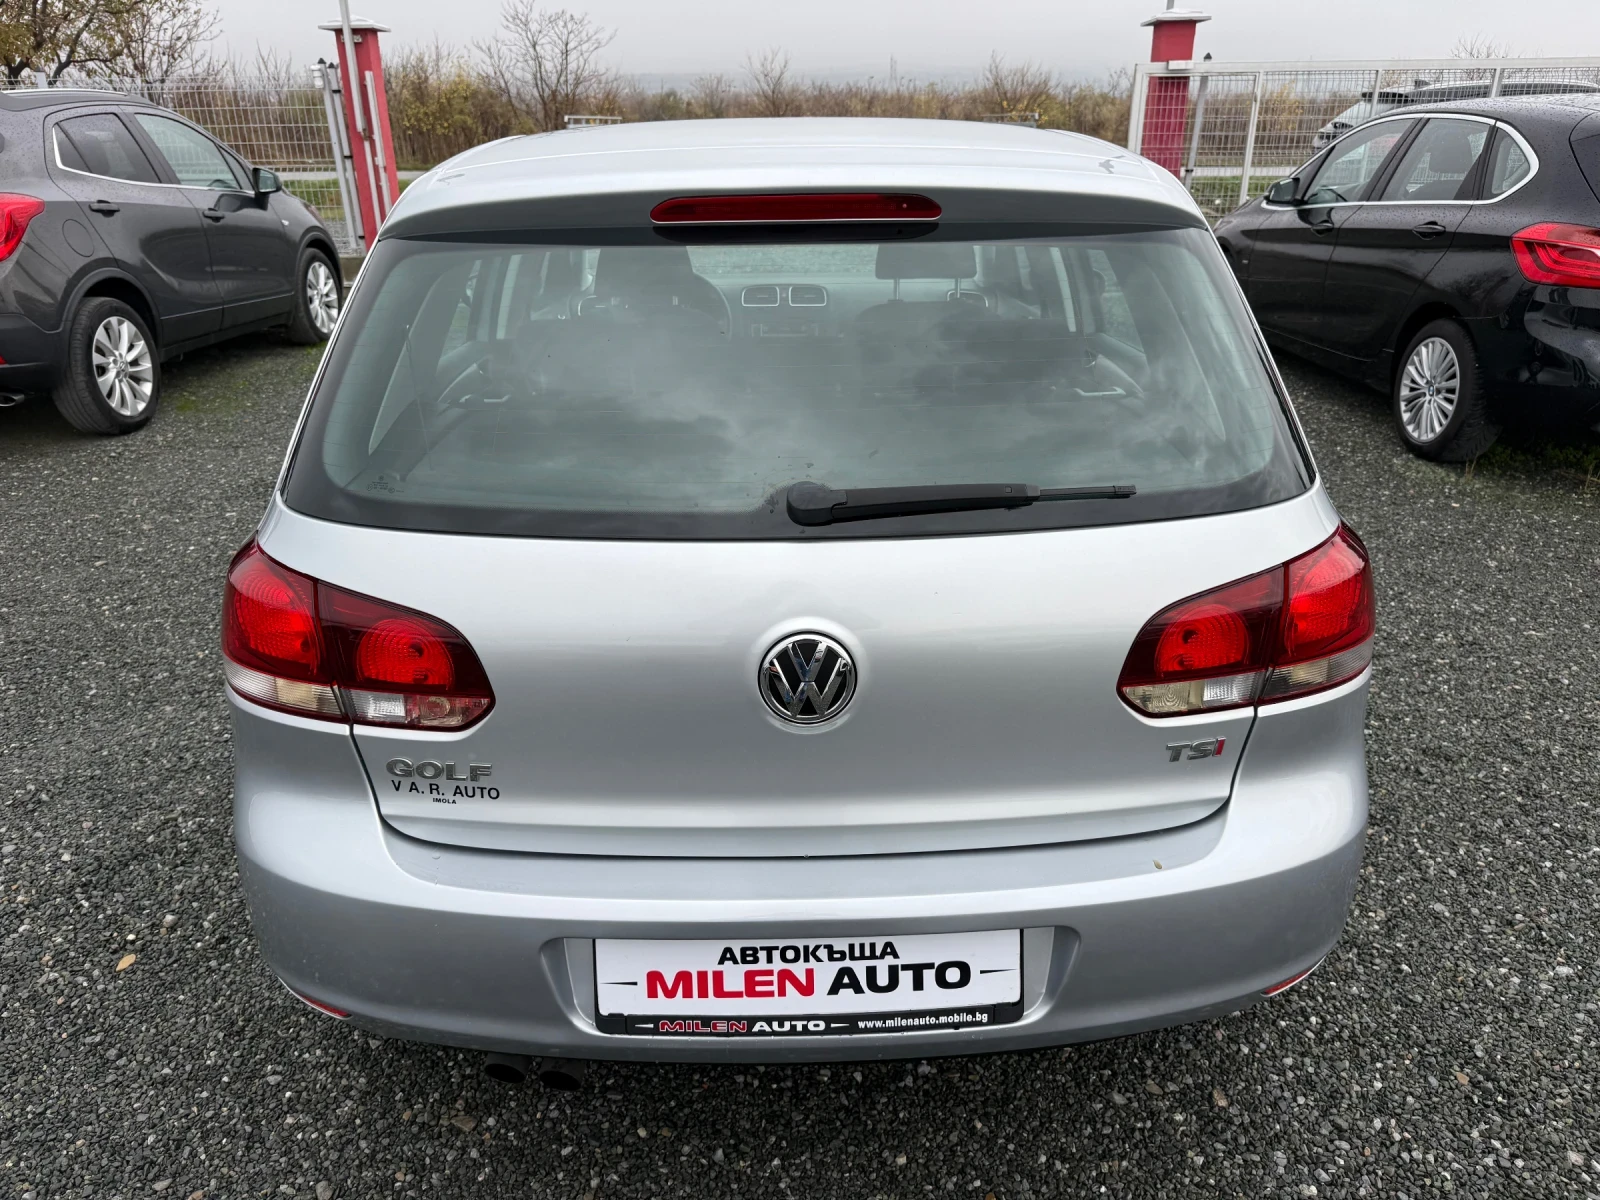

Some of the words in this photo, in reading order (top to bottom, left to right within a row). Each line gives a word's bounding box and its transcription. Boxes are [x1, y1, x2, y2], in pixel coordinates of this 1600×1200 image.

[386, 757, 492, 781] GOLF
[453, 785, 500, 800] AUTO
[717, 941, 900, 965] АВТОКЪЩА
[646, 968, 815, 999] MILEN
[827, 960, 972, 996] AUTO
[659, 1020, 748, 1033] MILEN
[752, 1020, 826, 1033] AUTO
[858, 1012, 989, 1029] www.milenauto.mobile.bg
